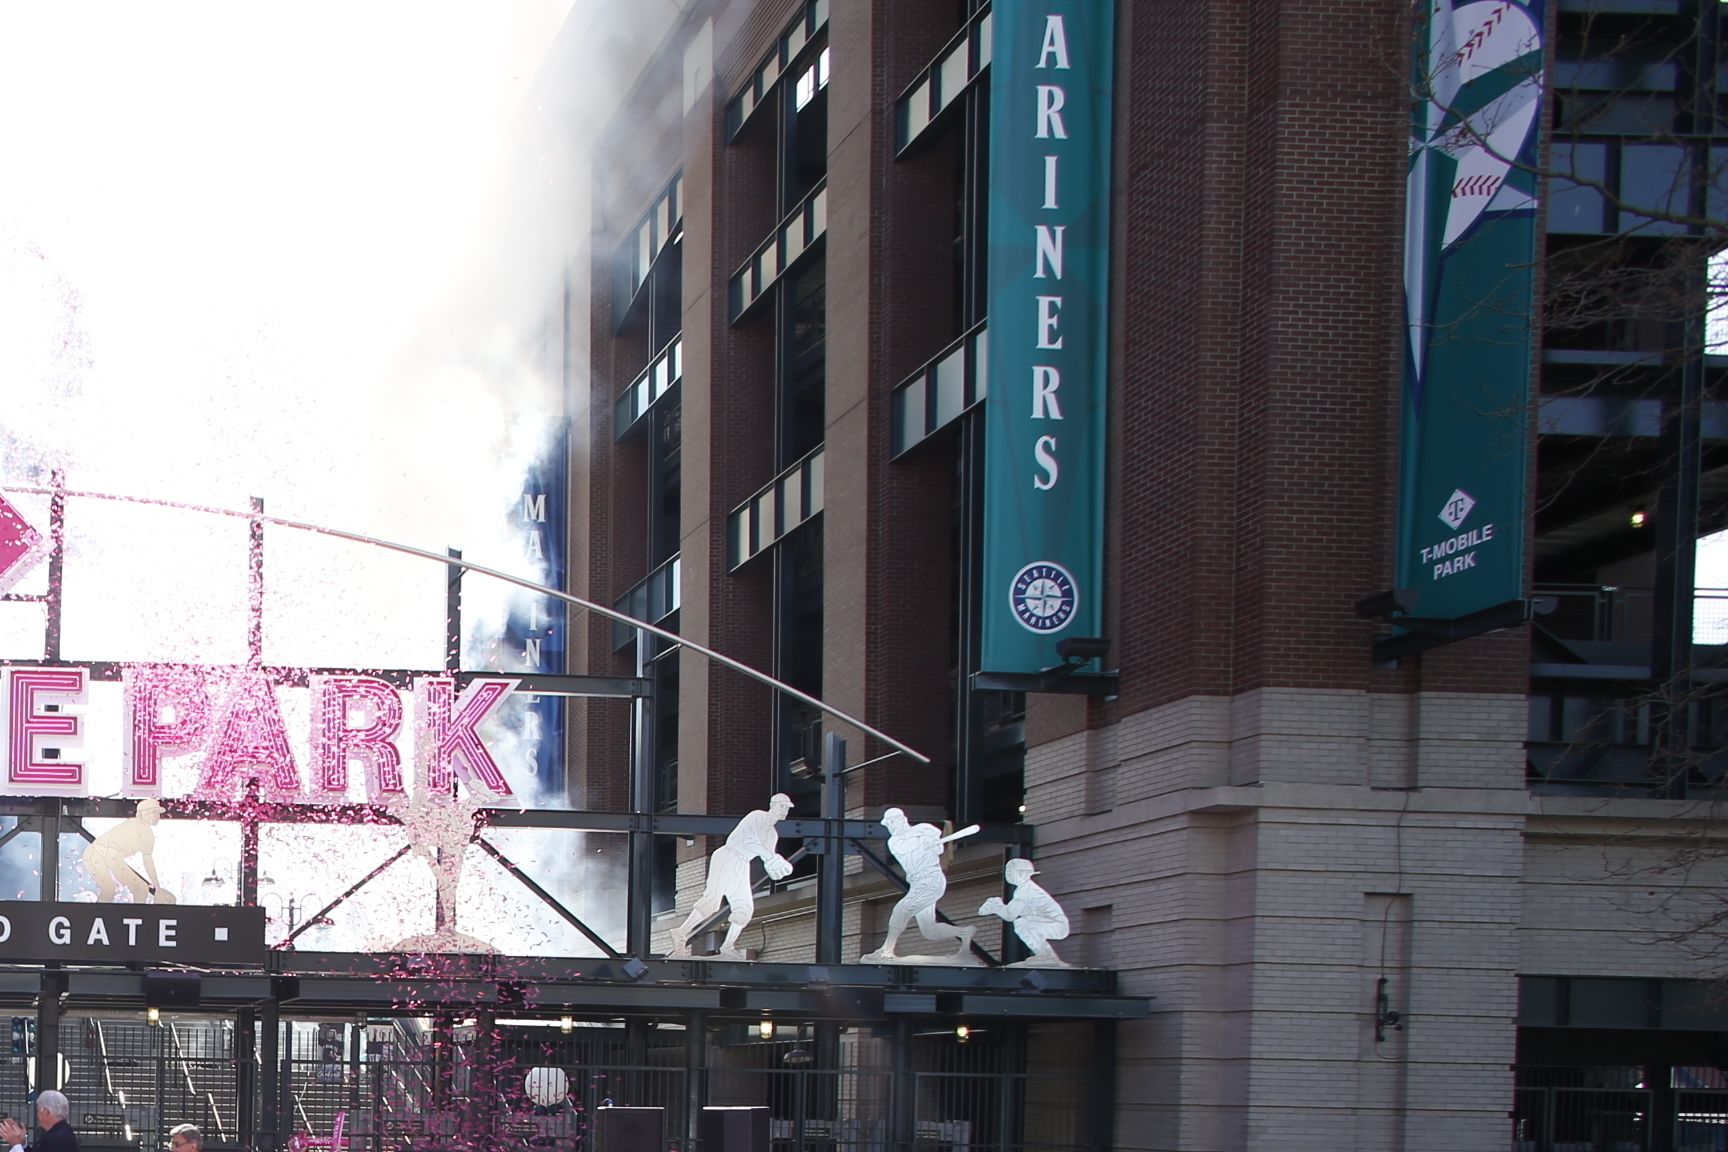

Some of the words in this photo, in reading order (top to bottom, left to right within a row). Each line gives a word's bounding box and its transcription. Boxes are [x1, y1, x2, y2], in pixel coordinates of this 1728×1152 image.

[1420, 523, 1493, 564] T-MOBILE
[1016, 567, 1071, 591] SEATTLE
[1433, 551, 1476, 581] PARK
[1016, 603, 1071, 628] MARINERS
[522, 494, 547, 777] MAINRS
[122, 664, 522, 804] PARK
[49, 917, 178, 948] GATE
